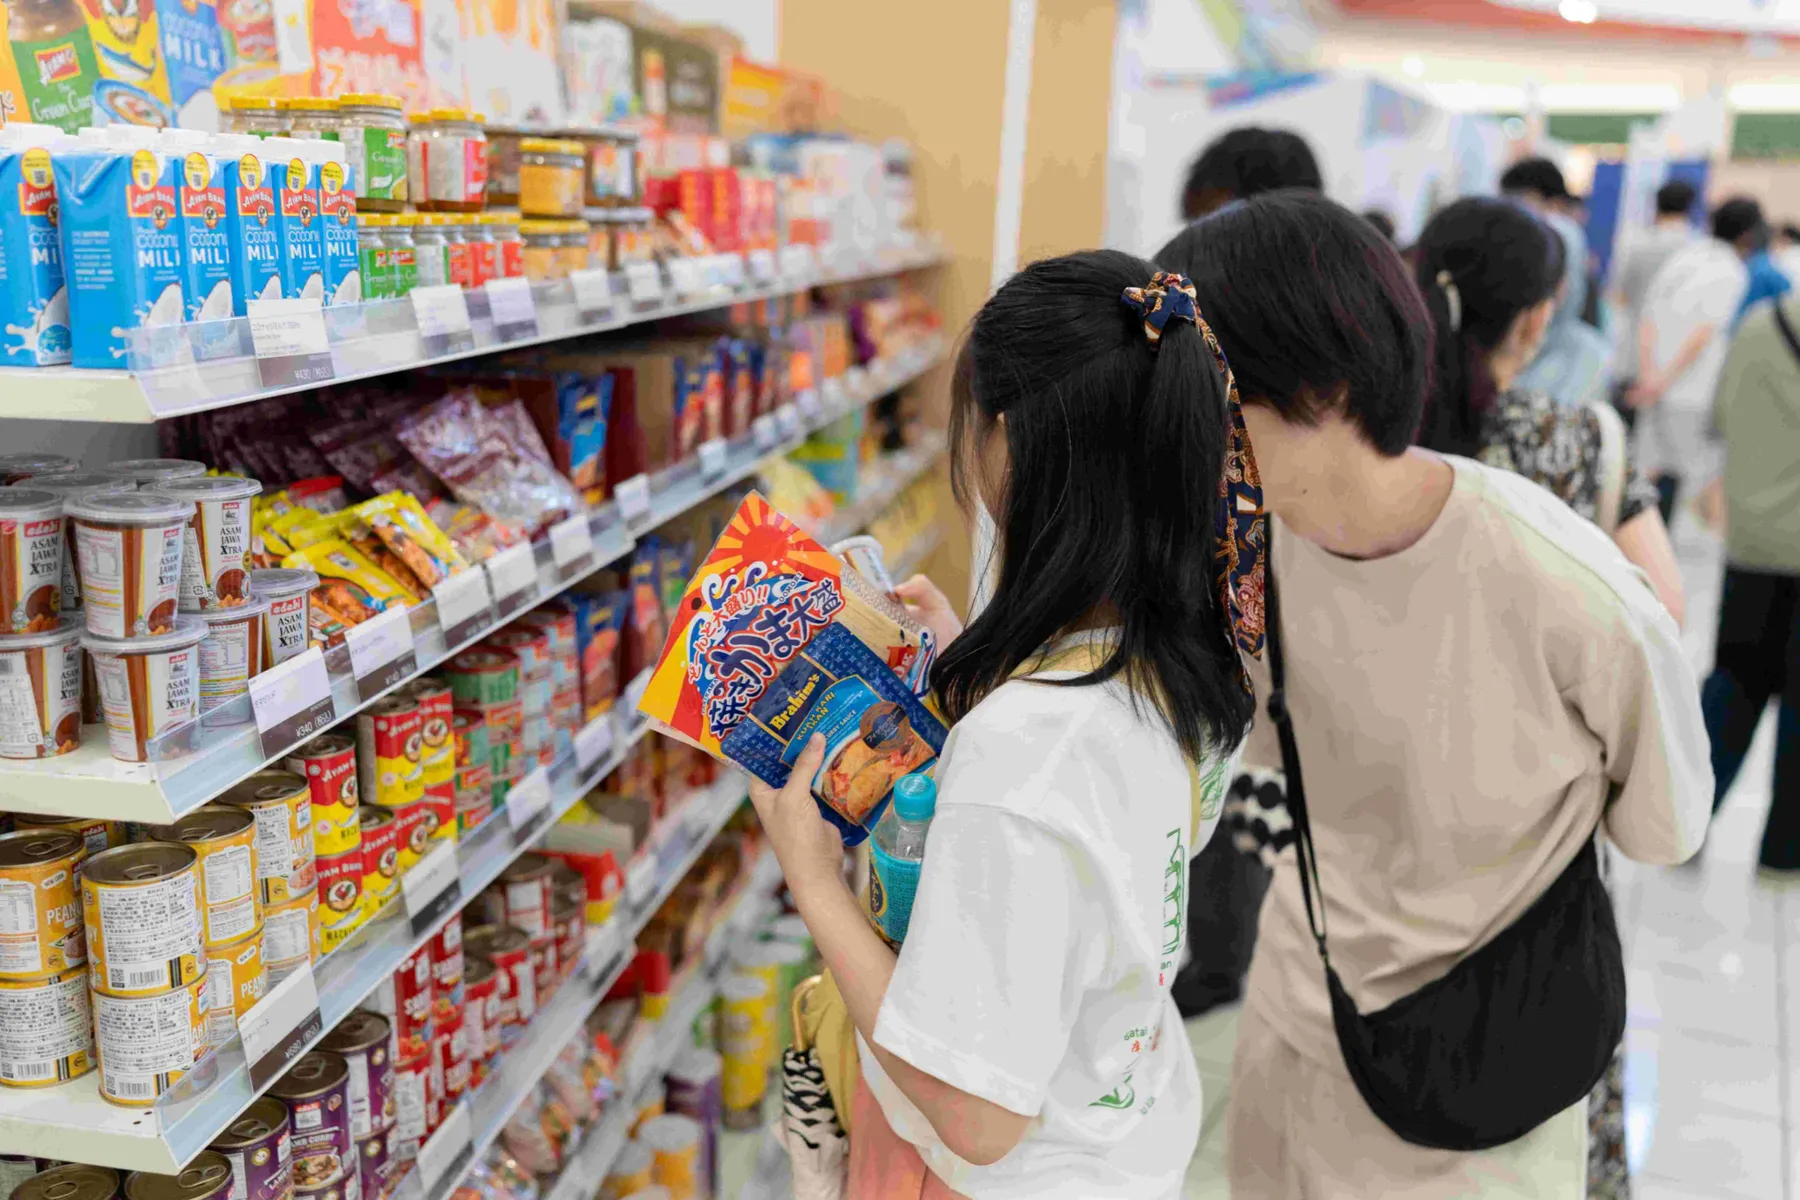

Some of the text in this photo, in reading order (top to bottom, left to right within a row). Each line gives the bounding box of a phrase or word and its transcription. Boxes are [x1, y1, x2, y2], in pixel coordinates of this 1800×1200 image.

[164, 32, 222, 72] MILK
[31, 247, 57, 266] MI
[220, 526, 242, 536] ASAM
[30, 536, 58, 551] ASAM
[220, 535, 241, 546] JAWA
[32, 548, 57, 562] JAWA
[220, 545, 243, 555] XTRA
[160, 554, 179, 566] ASAM
[30, 561, 58, 576] XTRA
[160, 564, 178, 575] JAWA
[158, 574, 177, 586] XTRA
[778, 571, 803, 604] OOMORI
[272, 599, 302, 614] adabi
[277, 613, 303, 627] ASAM
[279, 623, 303, 637] JAWA
[278, 633, 304, 648] XTRA
[708, 577, 842, 739] 焼きかま大盛
[61, 667, 80, 680] ASAM
[61, 678, 79, 690] JAWA
[166, 677, 190, 690] ASAM
[60, 688, 80, 700] XTRA
[167, 688, 189, 701] JAWA
[166, 699, 191, 711] XTRA
[769, 672, 821, 731] Brahim's
[809, 706, 830, 730] IKAN
[839, 709, 858, 727] SAUCE
[295, 721, 313, 738] ¥340
[322, 762, 349, 783] AYAM
